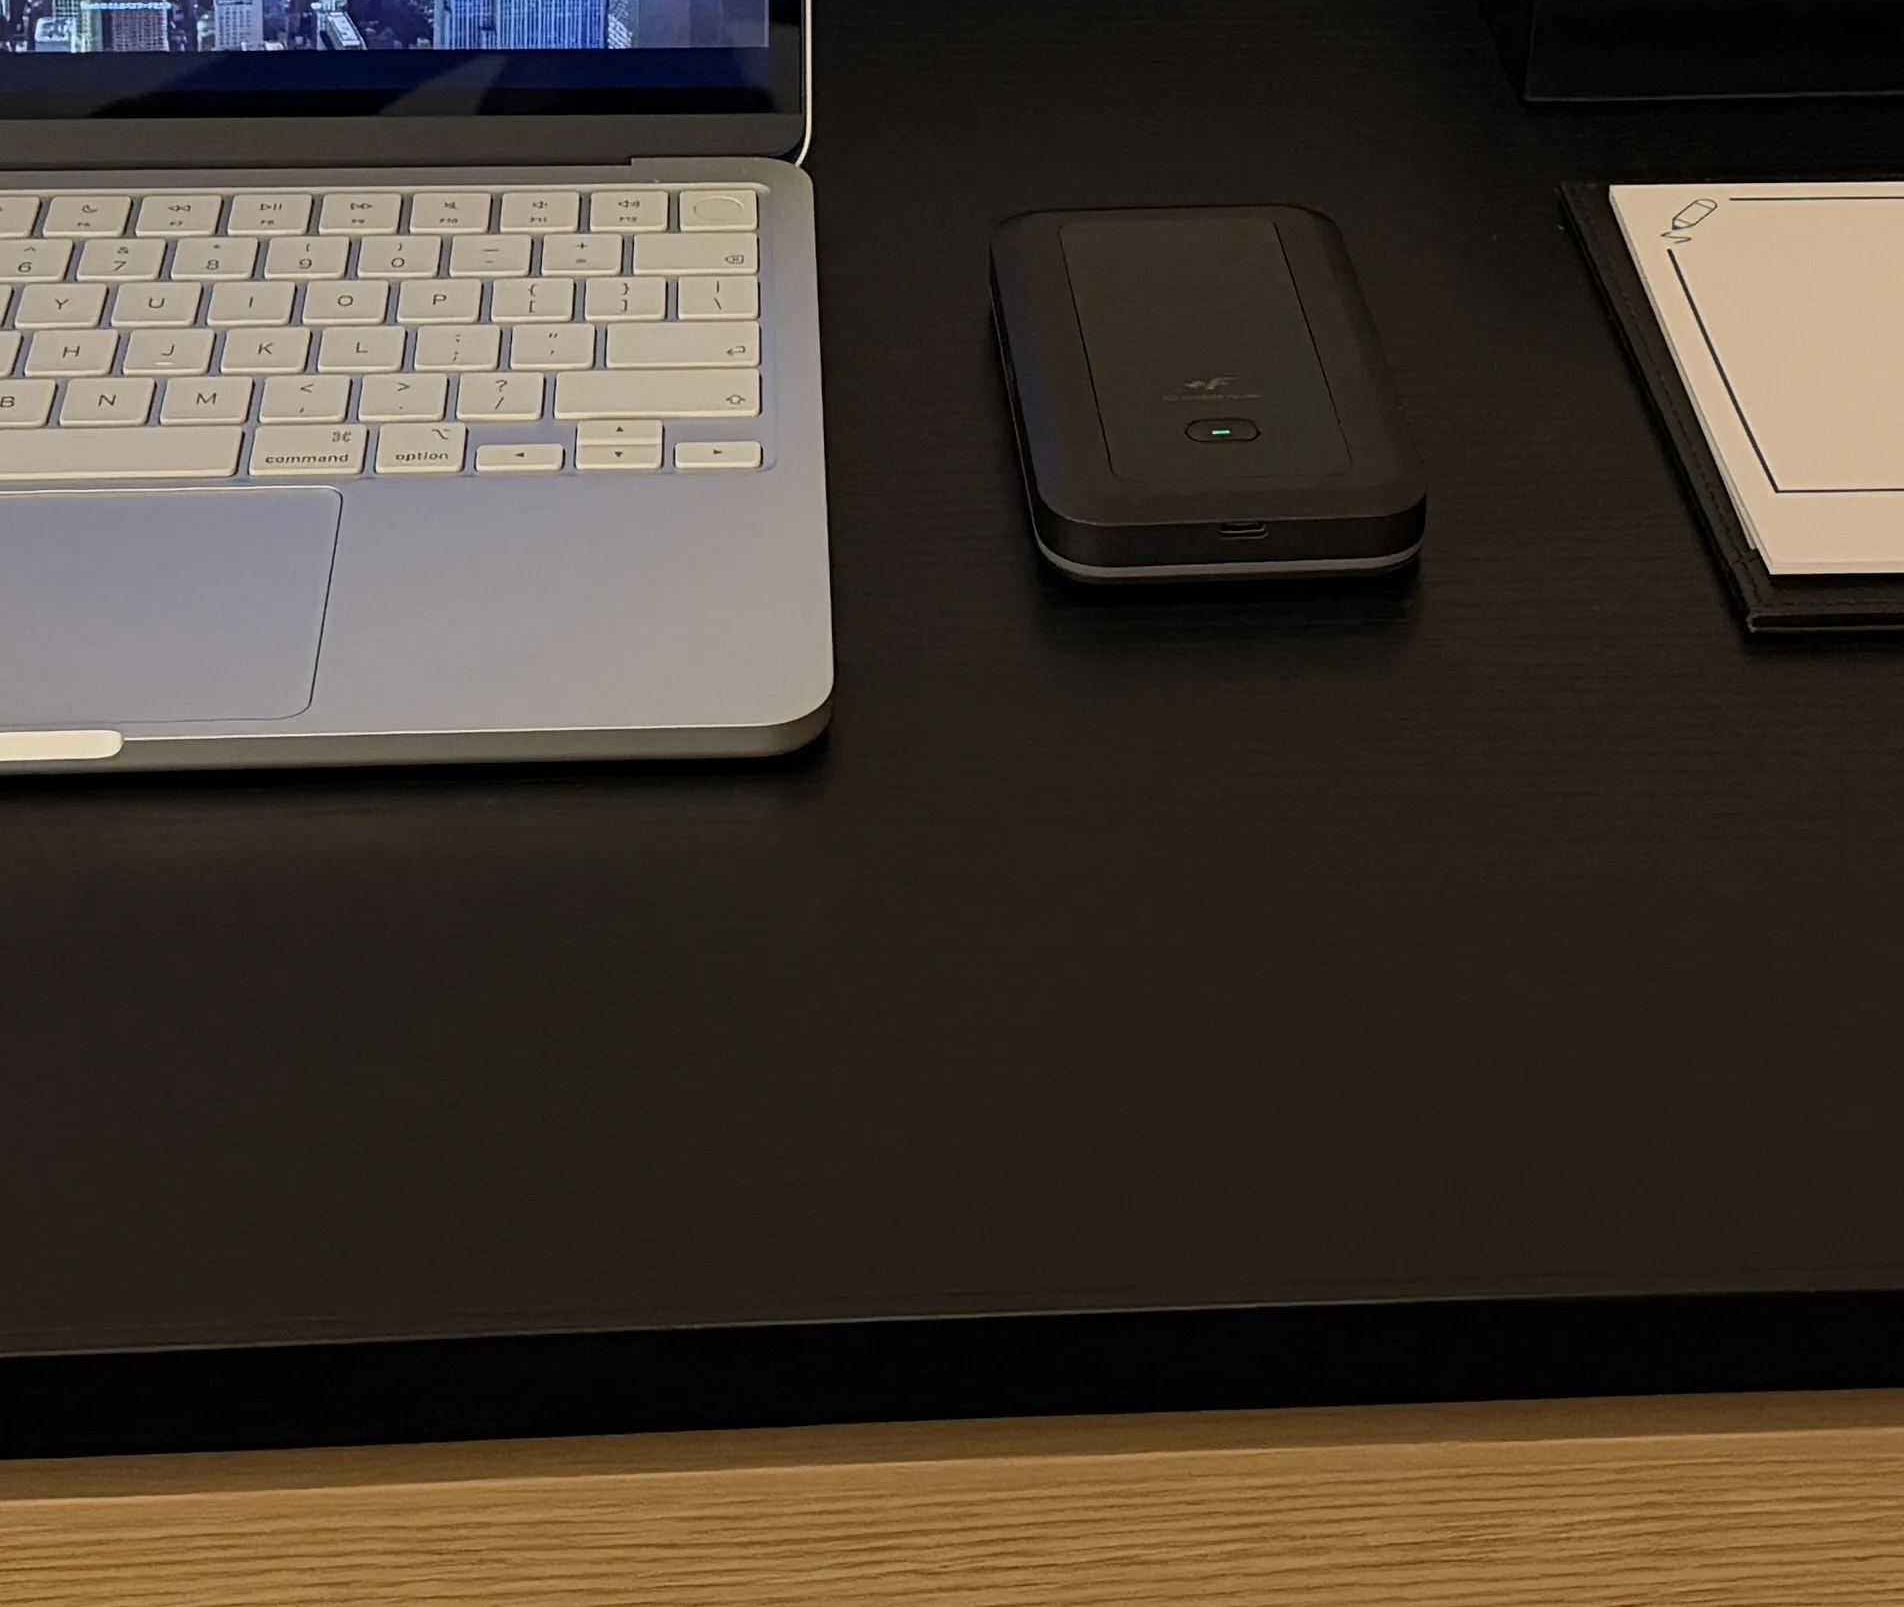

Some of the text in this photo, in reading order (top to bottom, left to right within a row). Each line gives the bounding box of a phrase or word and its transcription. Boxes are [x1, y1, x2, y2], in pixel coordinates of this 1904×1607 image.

[17, 261, 32, 273] 6
[113, 260, 127, 272] 7
[205, 259, 220, 271] 8
[298, 258, 313, 270] 9
[390, 257, 405, 268] 0
[55, 298, 69, 311] Y
[148, 297, 165, 309] U
[337, 295, 354, 307] O
[432, 294, 447, 306] P
[62, 345, 81, 358] H
[161, 344, 175, 357] J
[257, 343, 272, 355] K
[355, 341, 368, 354] L
[0, 395, 16, 408] B
[97, 394, 117, 407] N
[196, 392, 217, 405] M
[264, 453, 349, 464] command
[395, 451, 449, 462] option
